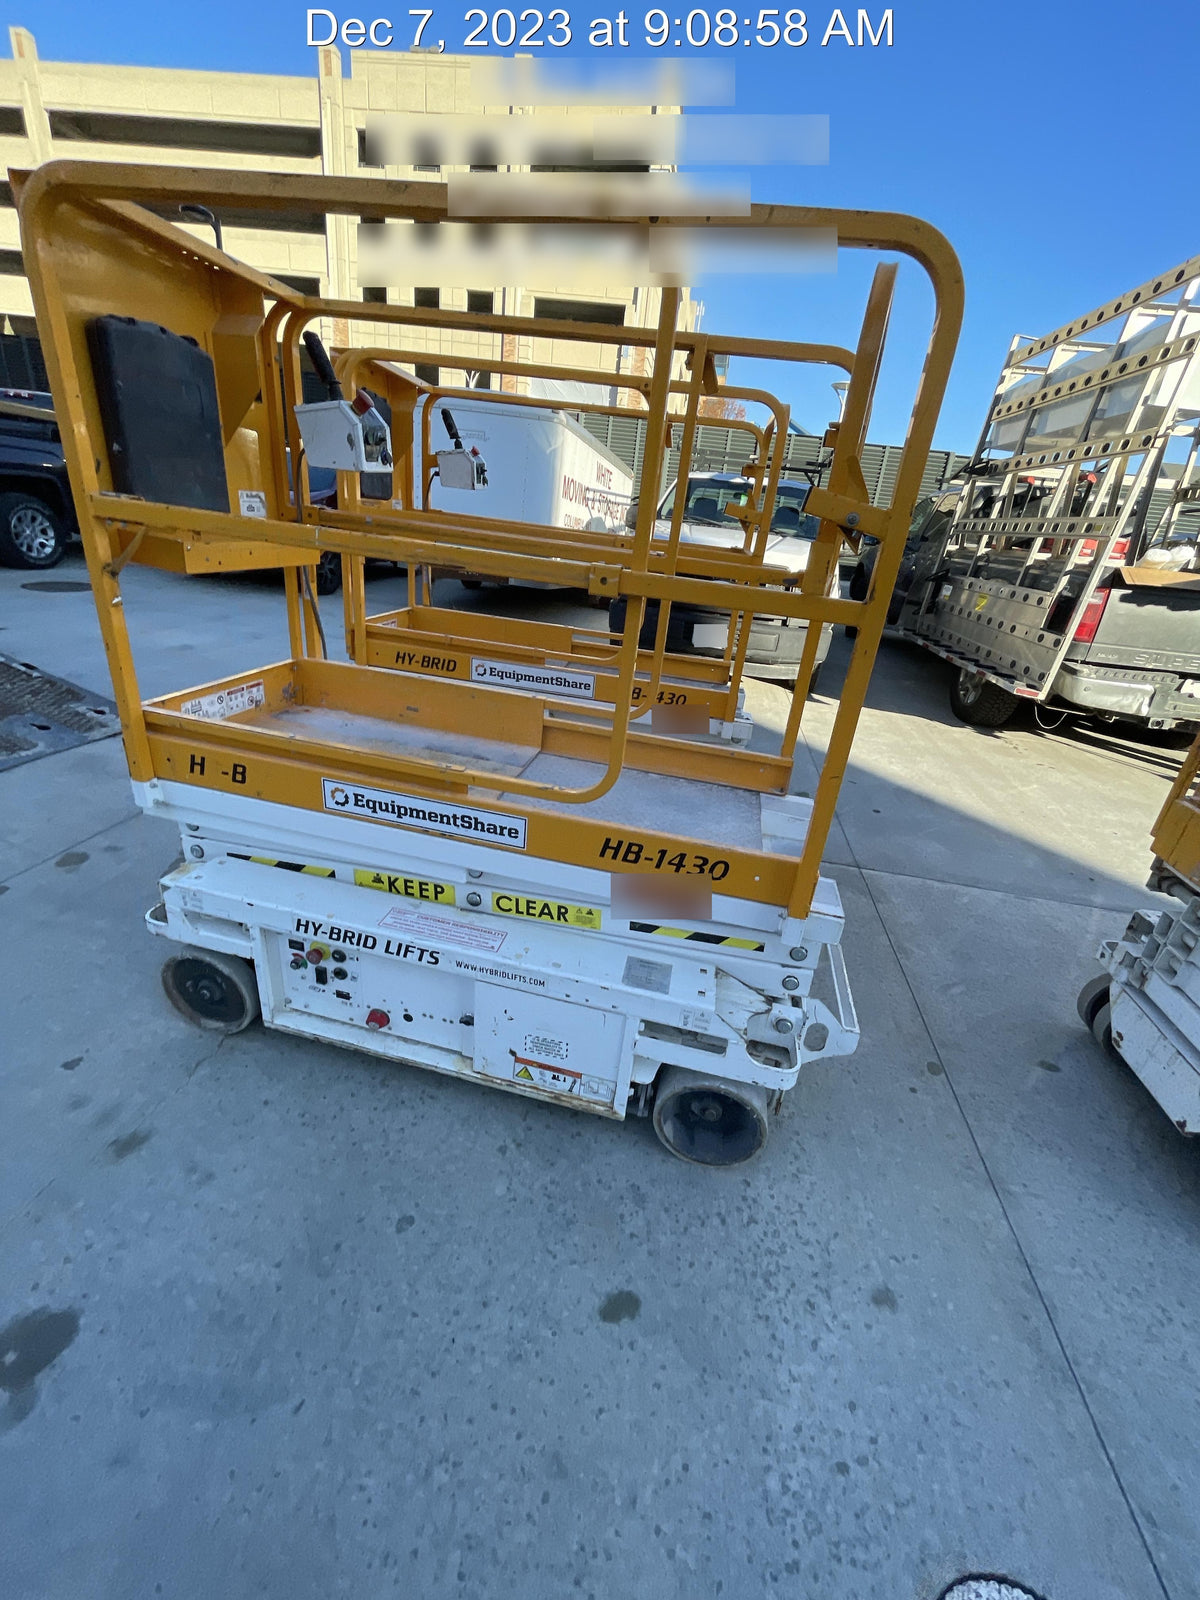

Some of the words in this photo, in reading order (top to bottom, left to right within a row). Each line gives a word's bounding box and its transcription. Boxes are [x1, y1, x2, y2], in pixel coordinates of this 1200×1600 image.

[562, 475, 589, 507] MOVING
[596, 460, 613, 490] WHITE
[395, 651, 457, 673] HY-BRID
[489, 666, 592, 691] EquipmentShare
[352, 792, 520, 840] EquipmentShare
[599, 837, 730, 881] HB-1430
[387, 875, 445, 901] KEEP
[495, 895, 570, 923] CLEAR
[295, 918, 377, 950] HY-BRID
[384, 939, 441, 966] LIFTS
[455, 959, 546, 988] WWW.HYBRIDLIFTS.COM
